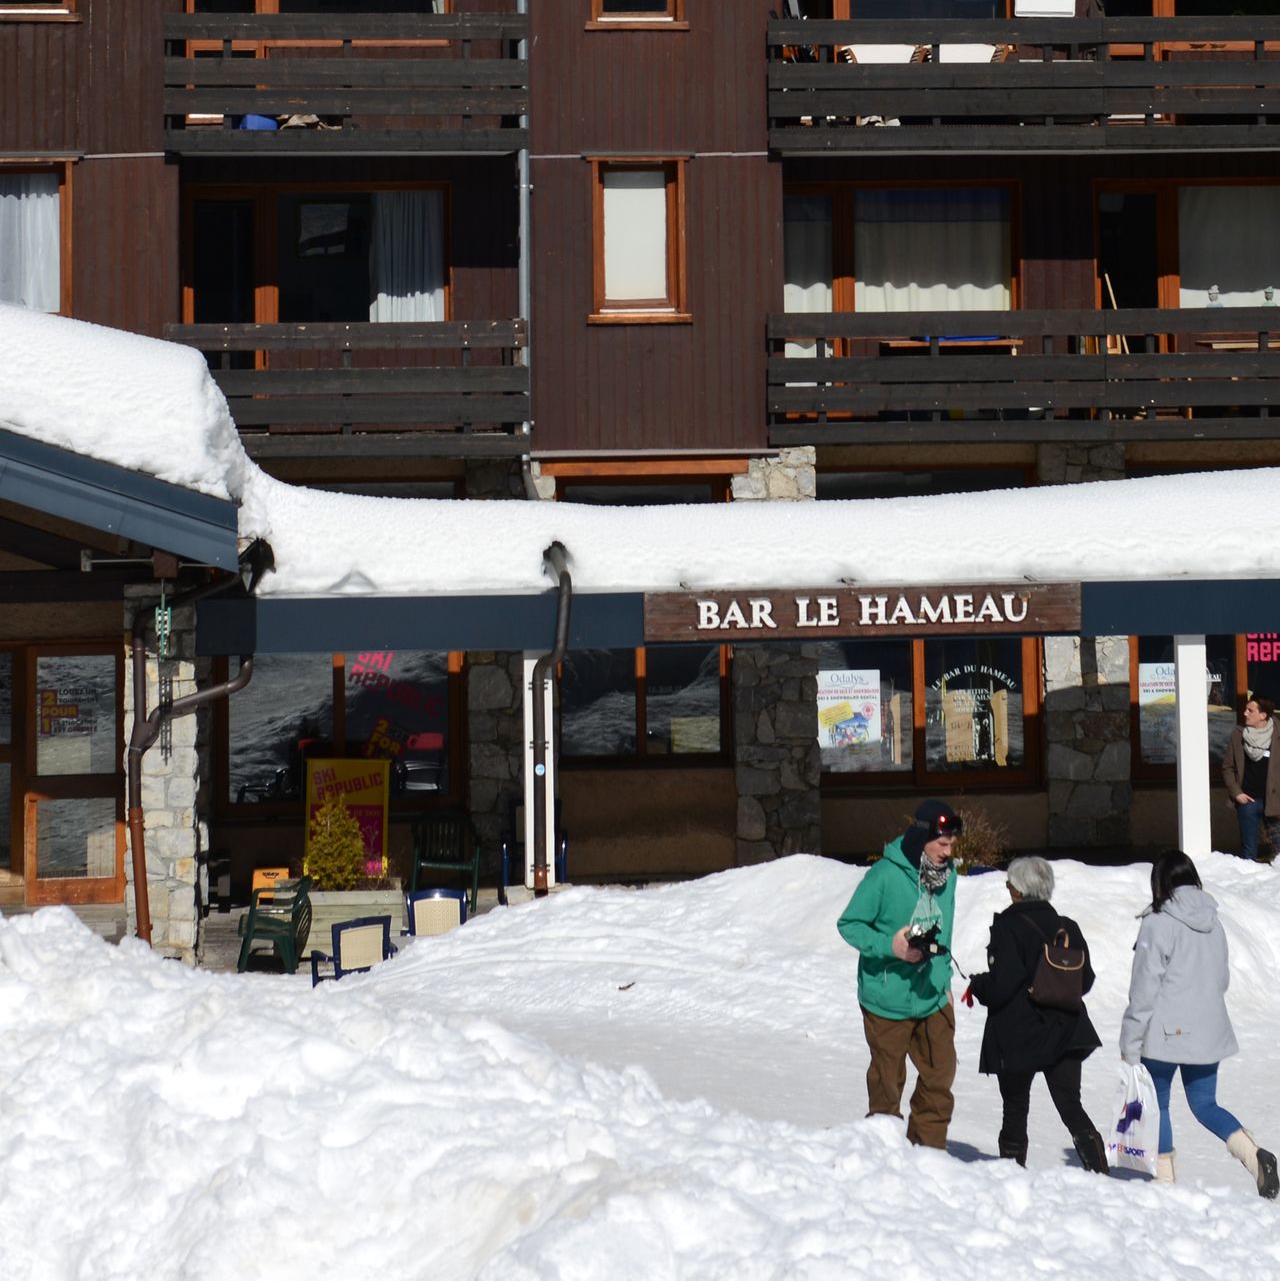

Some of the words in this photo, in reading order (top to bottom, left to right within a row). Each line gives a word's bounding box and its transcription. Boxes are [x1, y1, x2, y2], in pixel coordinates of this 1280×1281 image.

[696, 597, 777, 630] BAR
[795, 596, 840, 627] LE
[858, 592, 1032, 626] HAMEAU
[830, 673, 865, 685] Odalys
[931, 678, 942, 691] LE
[943, 667, 961, 681] BAR
[963, 664, 977, 673] DU
[980, 665, 1017, 690] HAMEAU
[43, 692, 54, 705] 2
[42, 706, 78, 717] POUR
[313, 767, 336, 785] SKI
